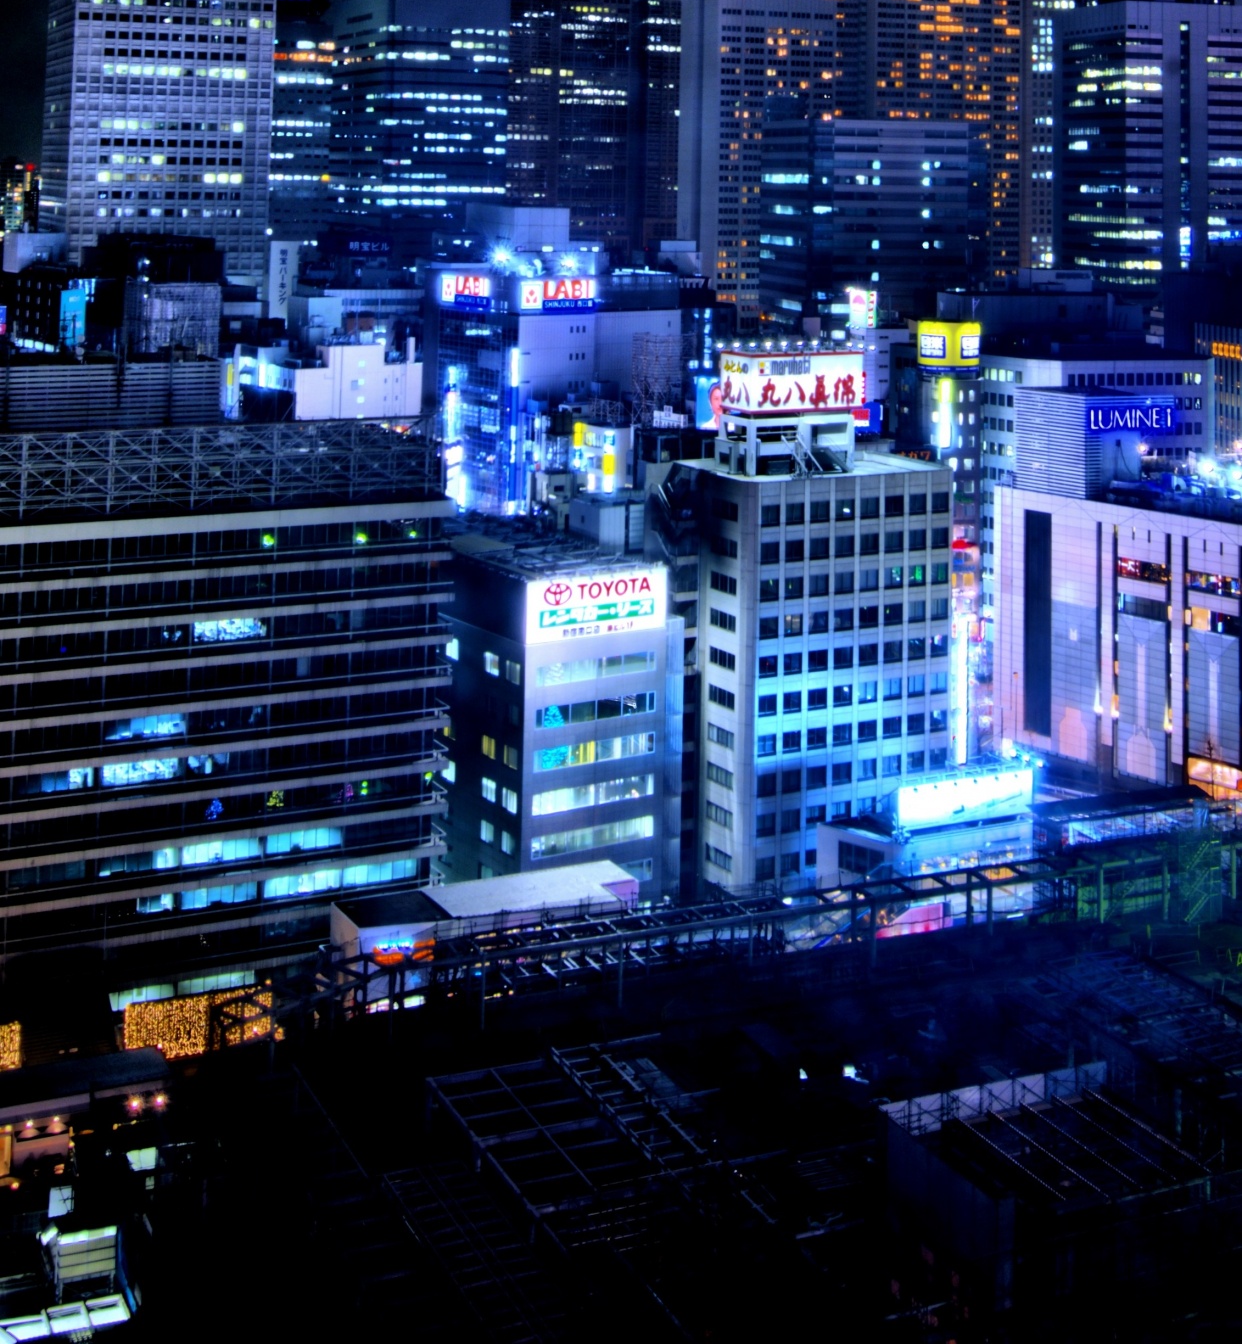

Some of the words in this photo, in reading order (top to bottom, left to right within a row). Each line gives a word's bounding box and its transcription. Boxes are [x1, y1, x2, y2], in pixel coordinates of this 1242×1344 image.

[349, 241, 390, 252] 明宝ビル
[455, 275, 486, 297] LABI
[543, 279, 590, 300] LABI
[544, 300, 575, 308] SHINJUKU
[1090, 408, 1160, 430] LUMINE
[577, 577, 651, 600] TOYOTA
